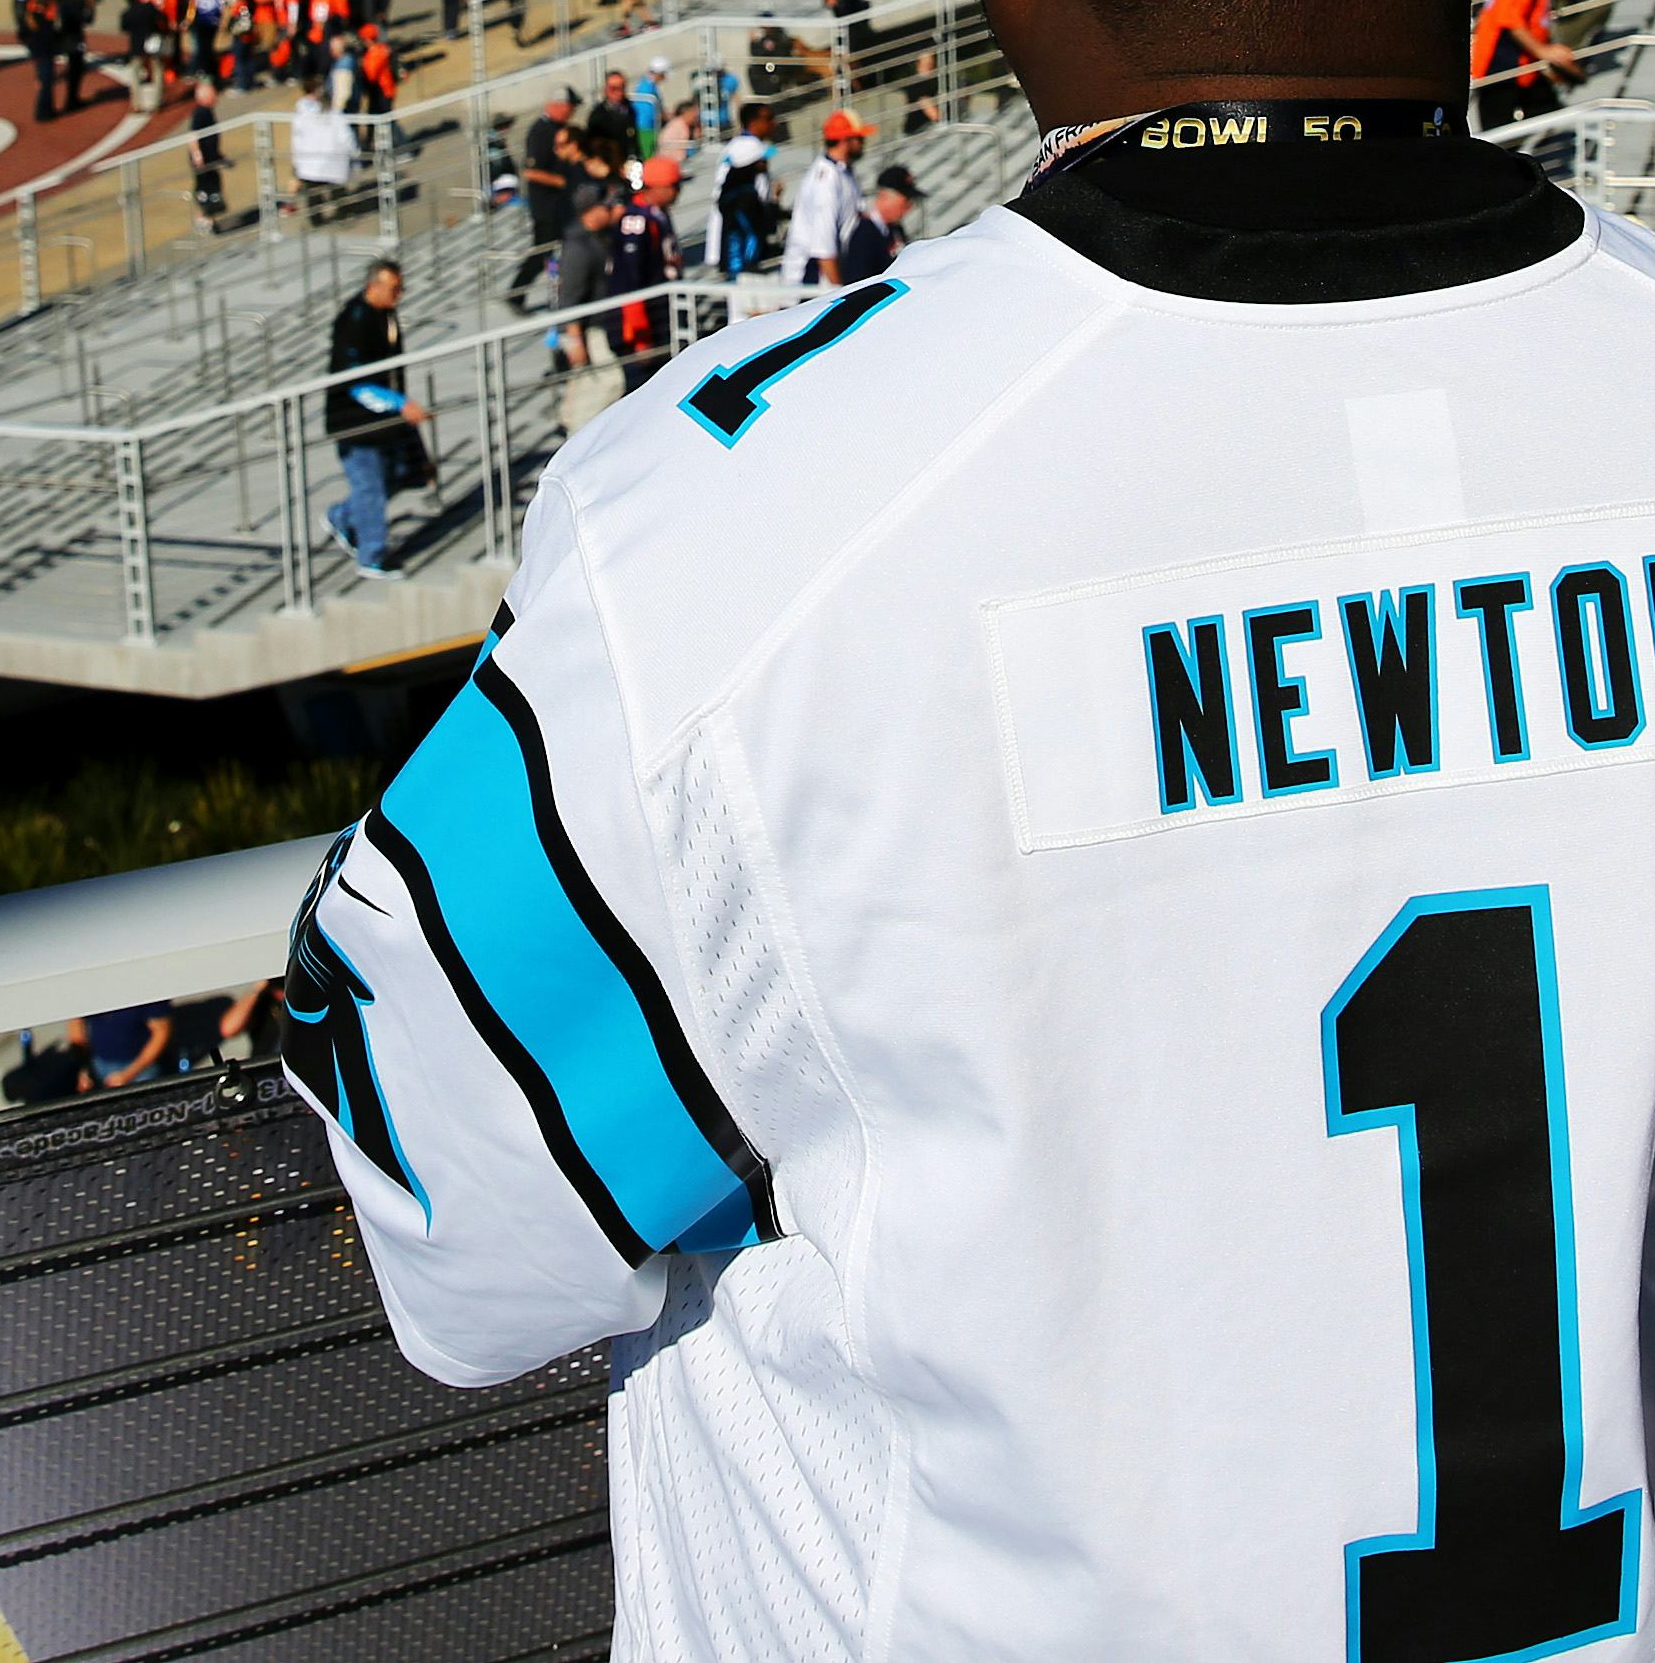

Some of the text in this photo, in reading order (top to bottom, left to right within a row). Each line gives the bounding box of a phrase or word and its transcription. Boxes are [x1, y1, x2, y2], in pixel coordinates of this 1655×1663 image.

[1304, 115, 1362, 142] 50
[676, 278, 911, 450] 1
[1320, 882, 1643, 1663] 1
